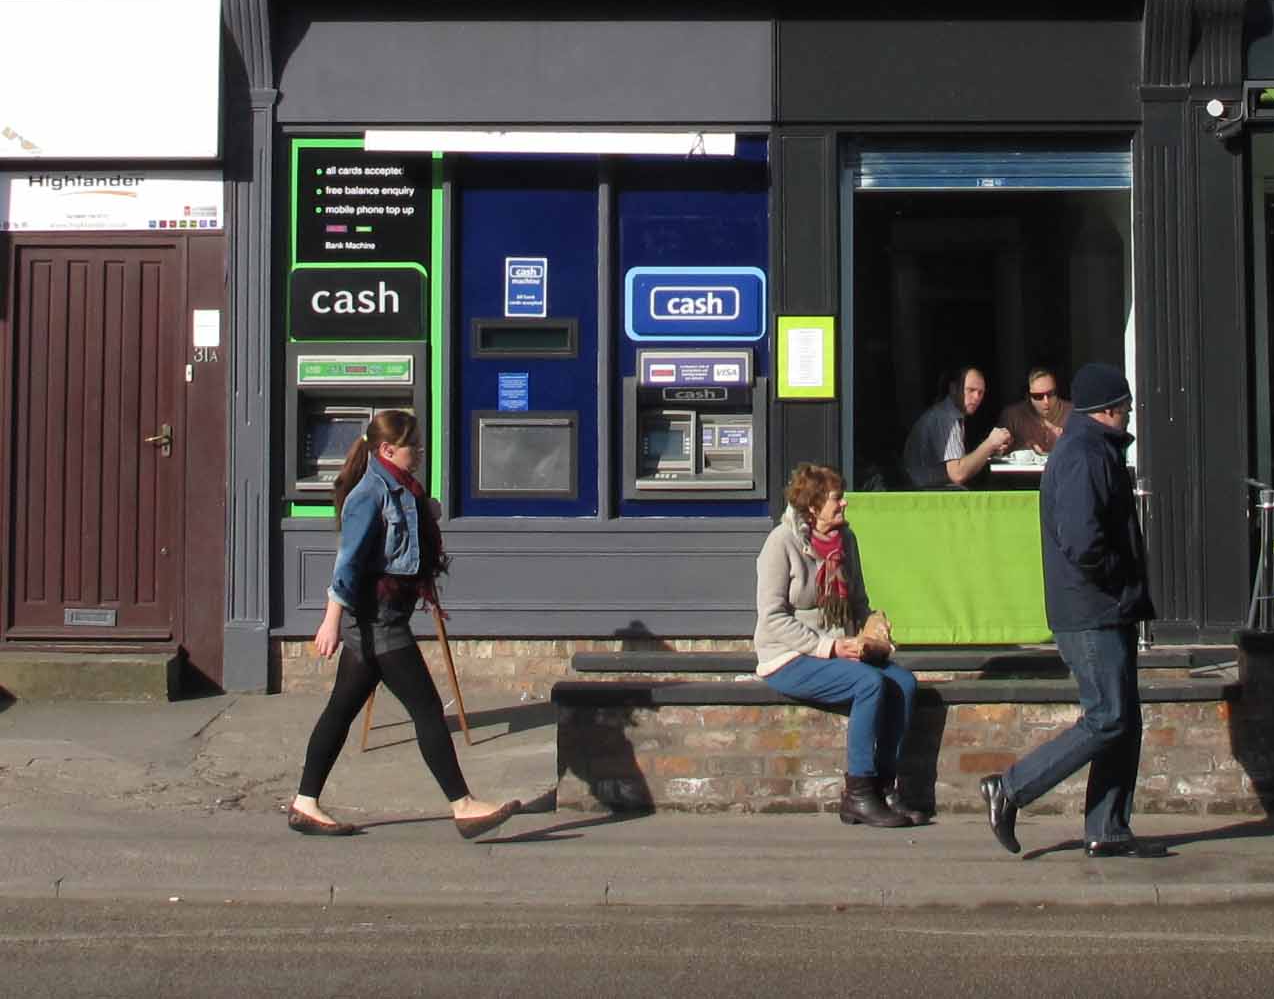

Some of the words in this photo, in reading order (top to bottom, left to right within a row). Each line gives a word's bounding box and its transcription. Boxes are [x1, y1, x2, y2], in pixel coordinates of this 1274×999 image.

[325, 166, 336, 176] all
[338, 166, 362, 176] cards
[28, 175, 144, 191] Highlander
[325, 185, 343, 195] free
[345, 185, 380, 195] balance
[381, 185, 415, 197] enquiry
[325, 205, 354, 215] mobile
[356, 205, 384, 217] phone
[386, 205, 400, 217] top
[402, 206, 415, 217] up
[325, 241, 343, 250] Bank
[345, 241, 376, 250] Machine
[311, 281, 399, 314] cash
[667, 292, 723, 314] cash
[674, 388, 716, 400] cash
